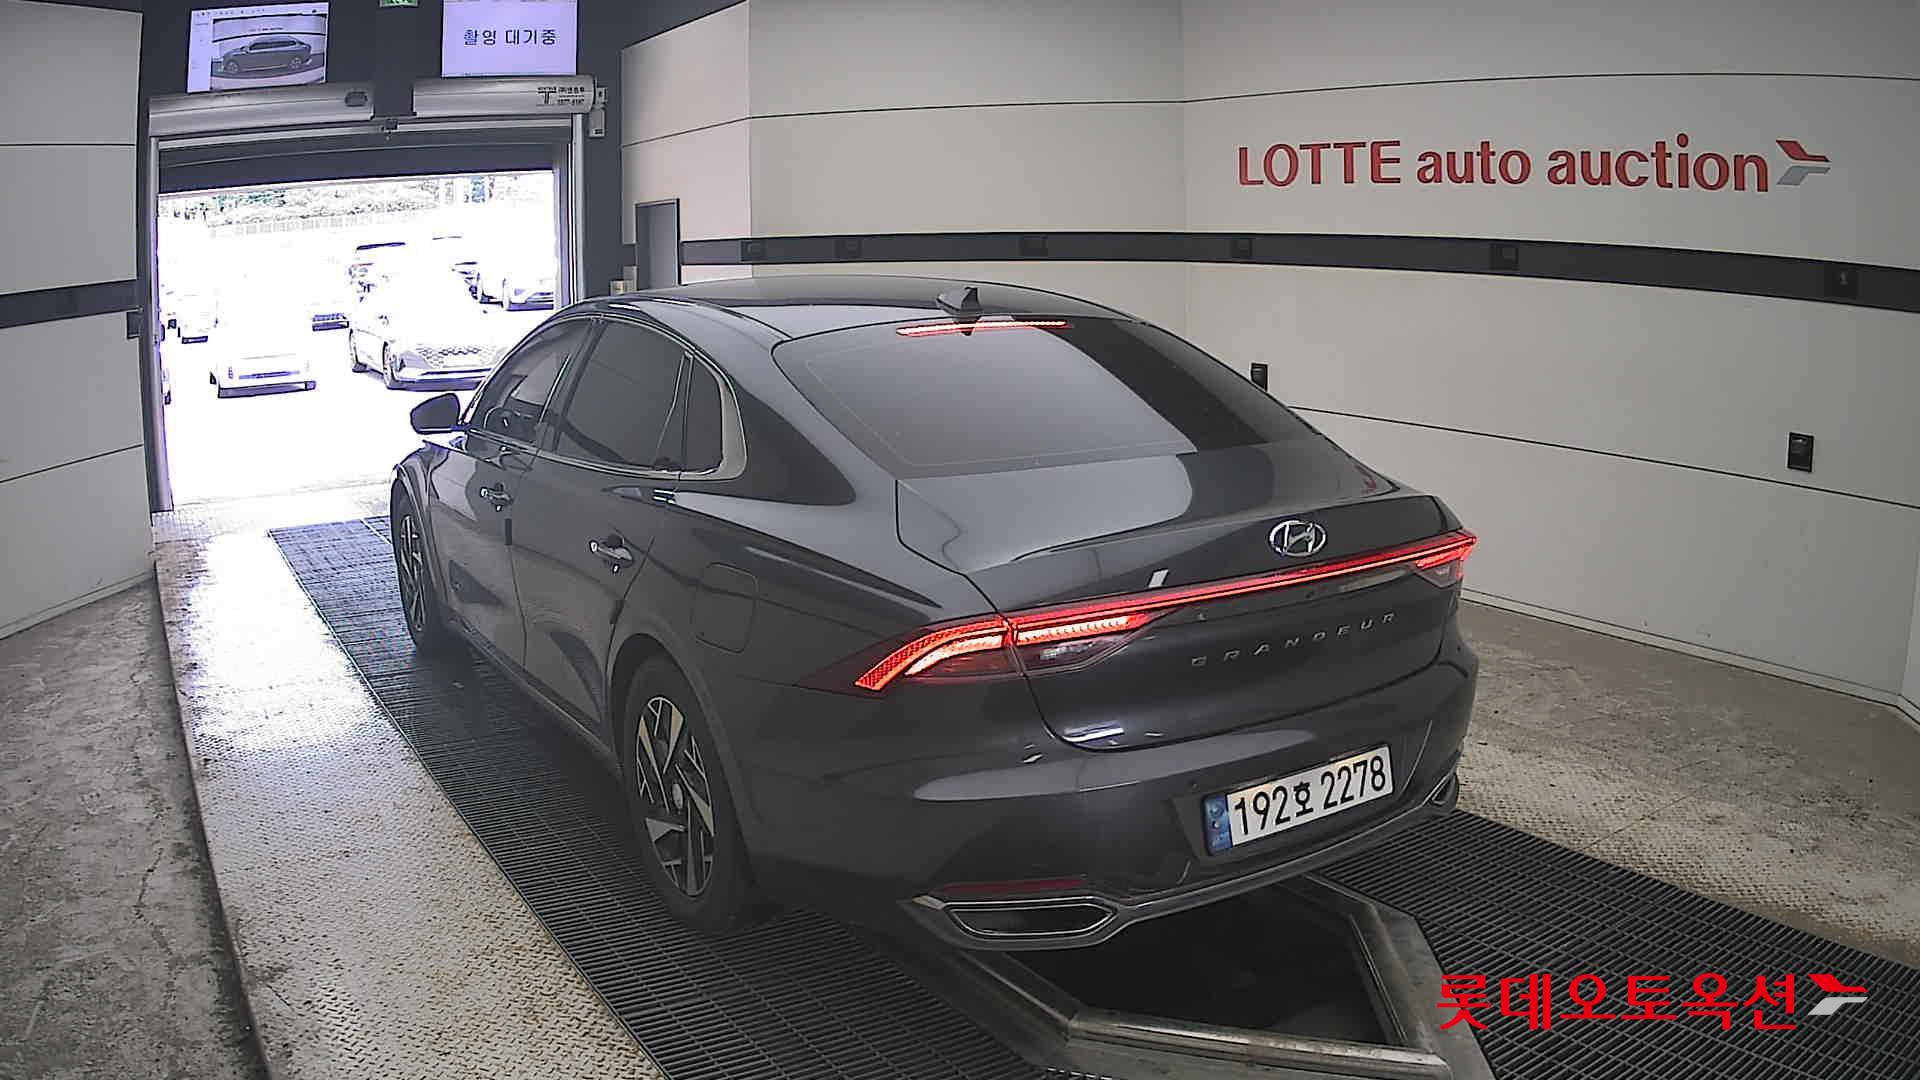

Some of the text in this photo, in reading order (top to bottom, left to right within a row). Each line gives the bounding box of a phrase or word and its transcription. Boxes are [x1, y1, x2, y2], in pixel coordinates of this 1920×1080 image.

[463, 28, 557, 46] 촬영 대기중
[1238, 133, 1769, 192] LOTTE auto auction
[1235, 755, 1387, 835] 192호 2278
